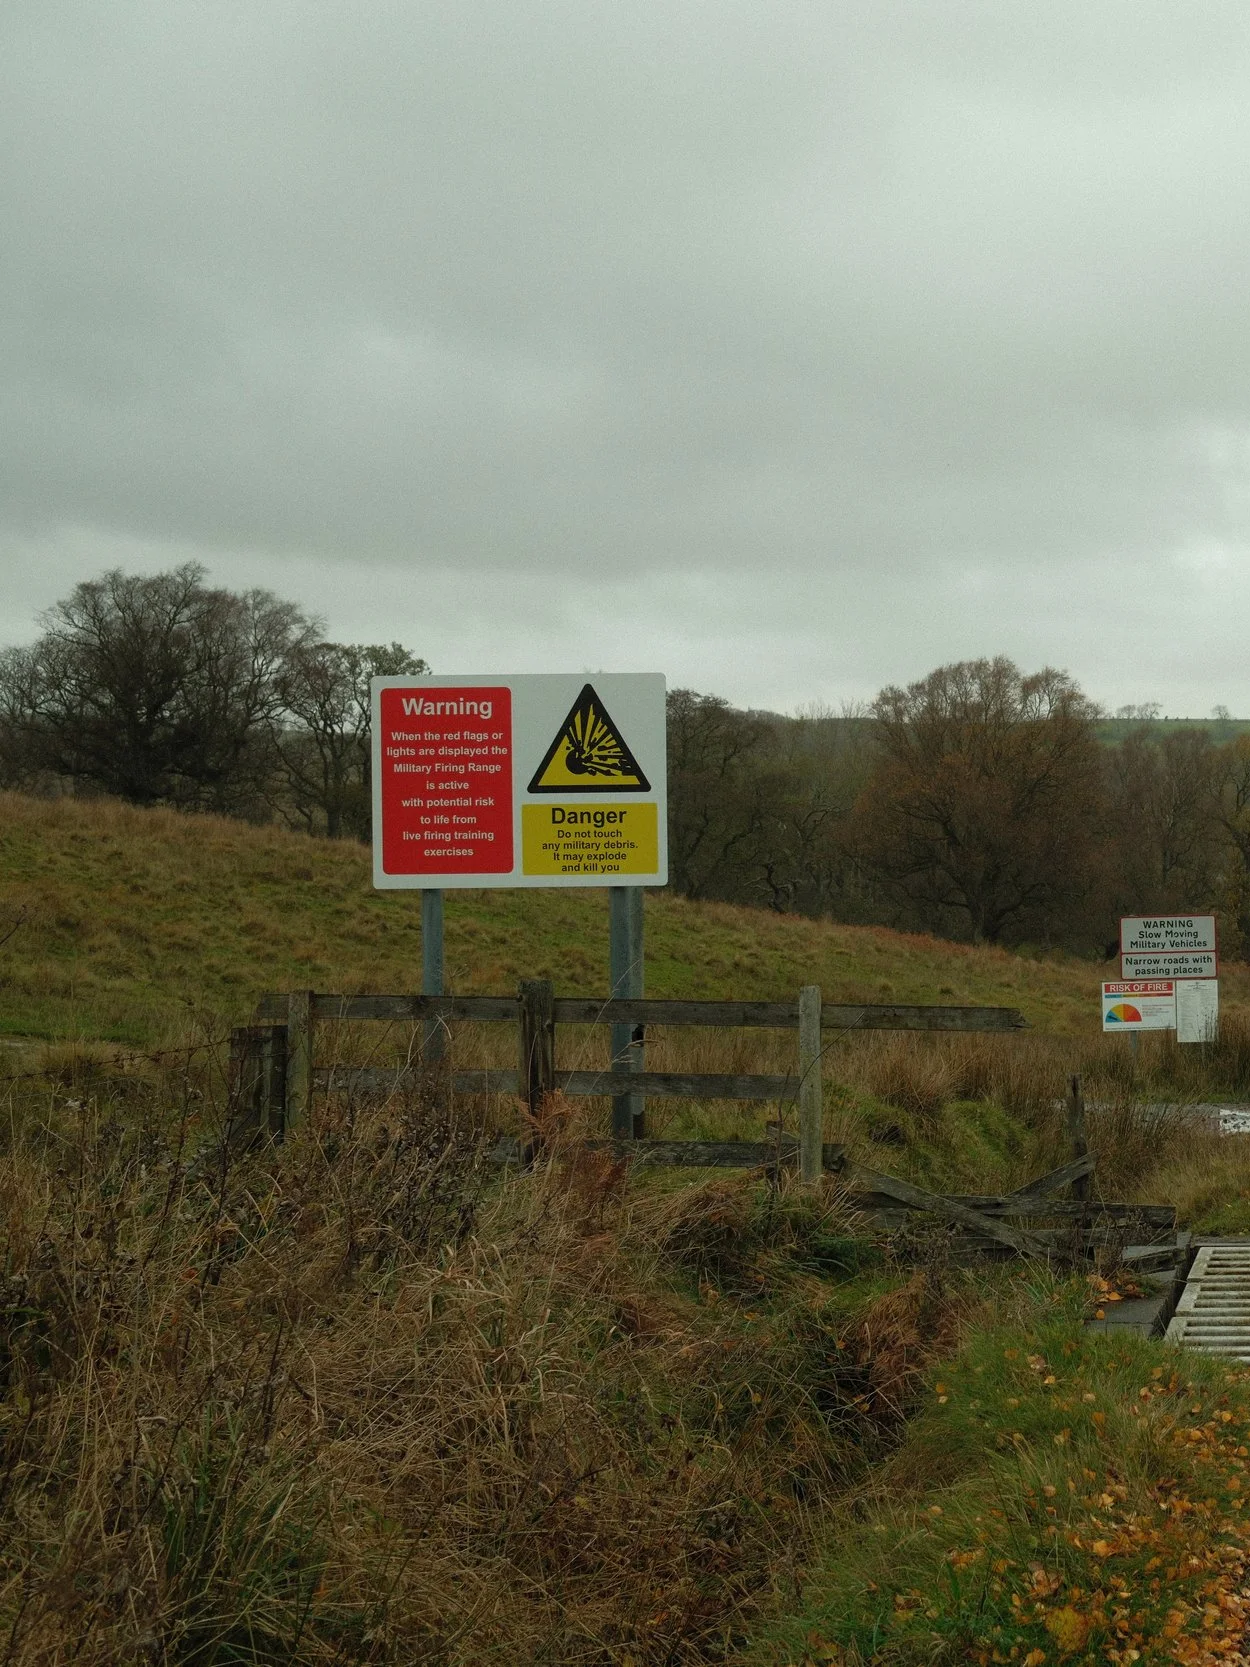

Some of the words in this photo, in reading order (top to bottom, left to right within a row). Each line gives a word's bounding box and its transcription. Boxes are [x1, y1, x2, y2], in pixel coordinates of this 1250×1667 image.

[402, 697, 492, 720] Warning
[391, 731, 421, 741] When
[424, 731, 440, 741] the
[443, 731, 460, 740] red
[463, 731, 488, 742] flags
[387, 746, 415, 756] lights
[438, 746, 488, 757] displayed
[491, 746, 508, 755] the
[394, 763, 431, 774] Military
[435, 763, 465, 774] Firing
[468, 763, 501, 774] Range
[426, 781, 435, 790] is
[439, 780, 469, 789] active
[402, 798, 423, 807] with
[427, 797, 472, 809] potential
[475, 797, 494, 806] risk
[420, 816, 431, 824] to
[434, 815, 449, 824] life
[453, 815, 476, 824] from
[551, 807, 627, 828] Danger
[403, 831, 420, 840] live
[424, 831, 451, 842] firing
[454, 830, 494, 841] training
[557, 830, 571, 838] Do
[593, 829, 622, 838] touch
[542, 842, 560, 851] any
[563, 840, 600, 850] military
[604, 840, 638, 849] debris.
[424, 847, 474, 857] exercises
[553, 852, 560, 860] It
[563, 853, 584, 862] may
[586, 851, 627, 862] explode
[561, 863, 580, 872] and
[583, 863, 597, 872] kill
[600, 865, 620, 873] you
[1143, 920, 1193, 929] WARNING
[1138, 931, 1162, 939] Slow
[1165, 930, 1198, 939] Moving
[1130, 940, 1166, 949] Military
[1169, 940, 1207, 948] Vehicles
[1126, 957, 1160, 966] Narrow
[1164, 956, 1189, 964] roads
[1135, 966, 1170, 976] passing
[1173, 966, 1203, 975] places
